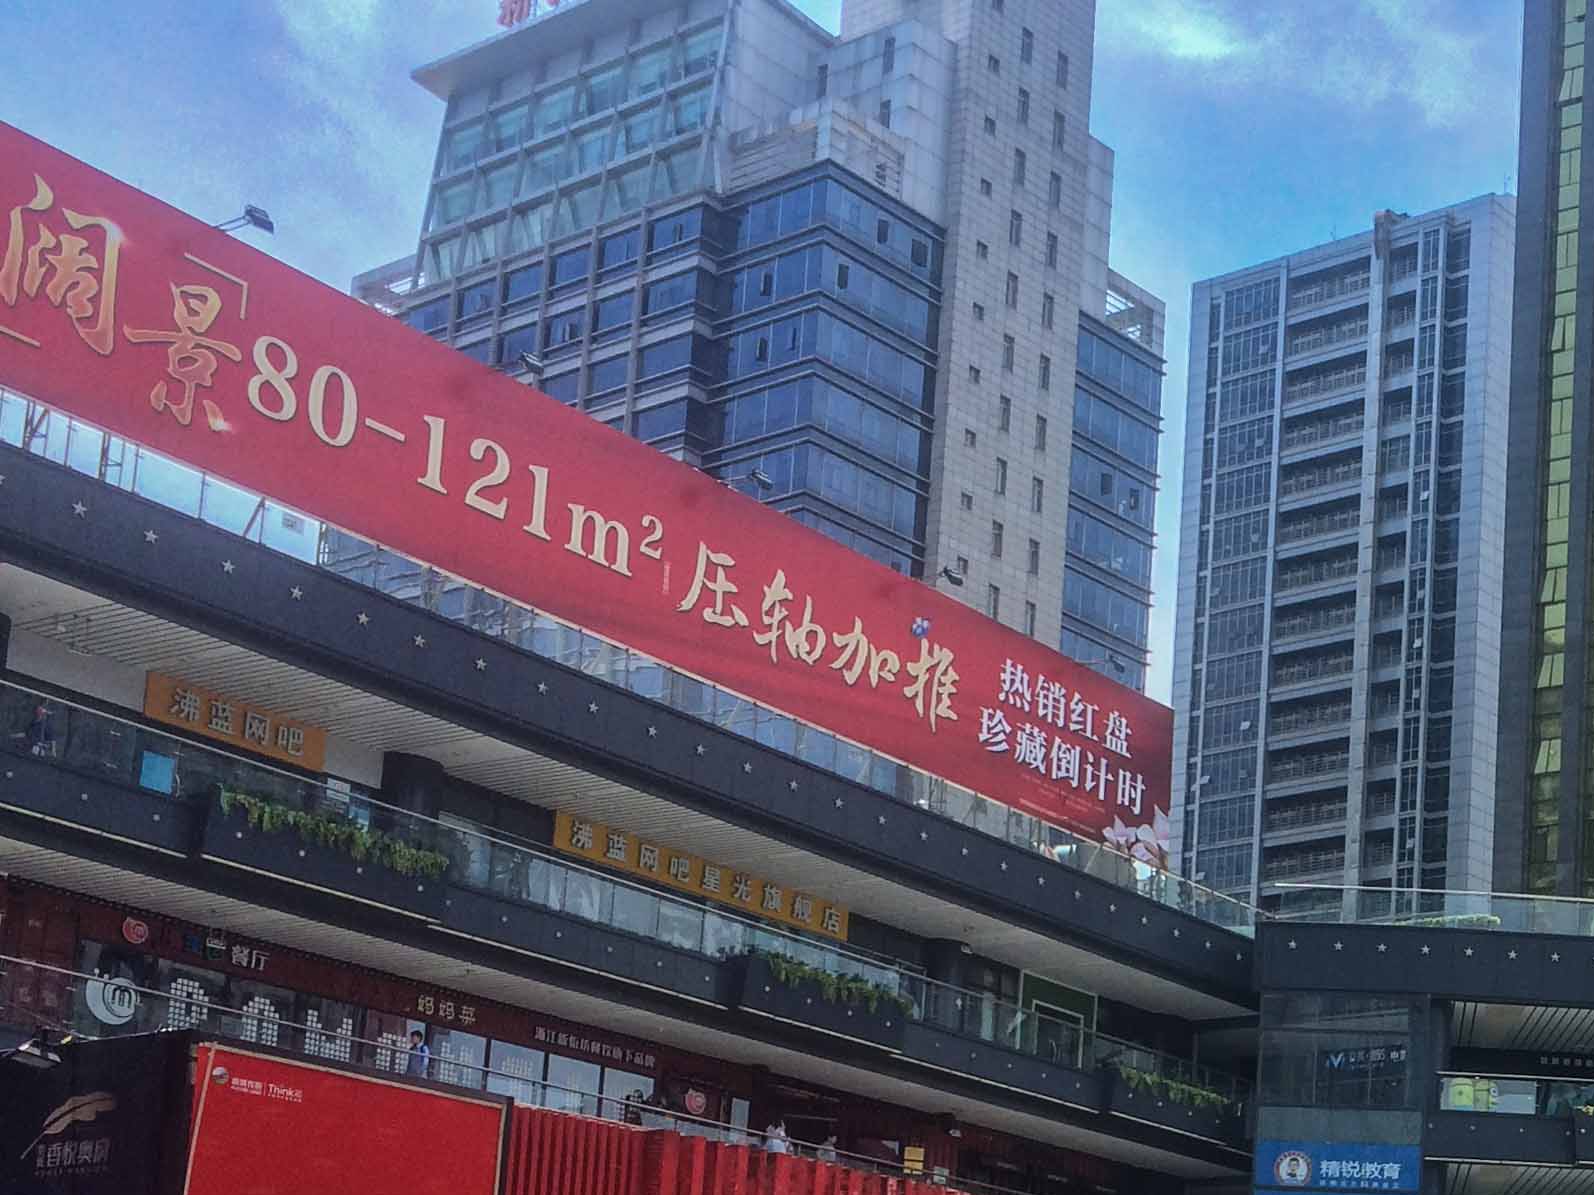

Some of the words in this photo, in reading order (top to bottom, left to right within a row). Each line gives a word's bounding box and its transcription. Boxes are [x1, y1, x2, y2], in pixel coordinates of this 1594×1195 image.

[676, 540, 961, 733] 压轴加推
[169, 686, 306, 758] 沸蓝网吧
[976, 705, 1147, 818] 珍藏倒计时
[998, 657, 1134, 761] 热销红盘
[570, 818, 841, 934] 沸蓝网吧星光旗舰店
